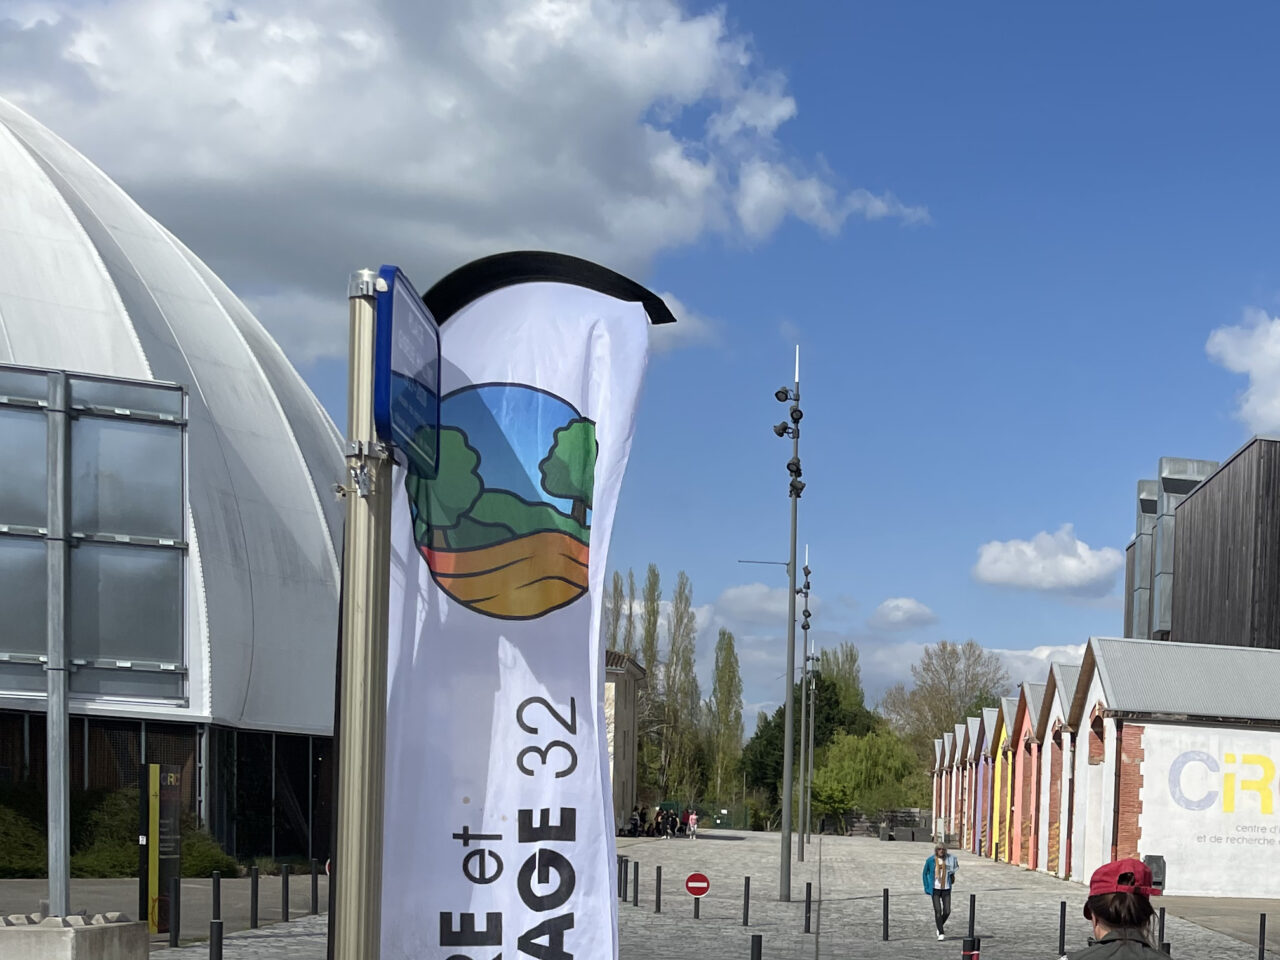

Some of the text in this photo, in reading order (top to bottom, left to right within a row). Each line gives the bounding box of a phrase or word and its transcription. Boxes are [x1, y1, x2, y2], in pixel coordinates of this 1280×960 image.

[516, 696, 578, 778] 32
[1196, 834, 1207, 843] et
[1209, 834, 1223, 844] de
[1225, 835, 1276, 846] recherche
[1235, 824, 1267, 834] centre
[452, 825, 504, 885] et
